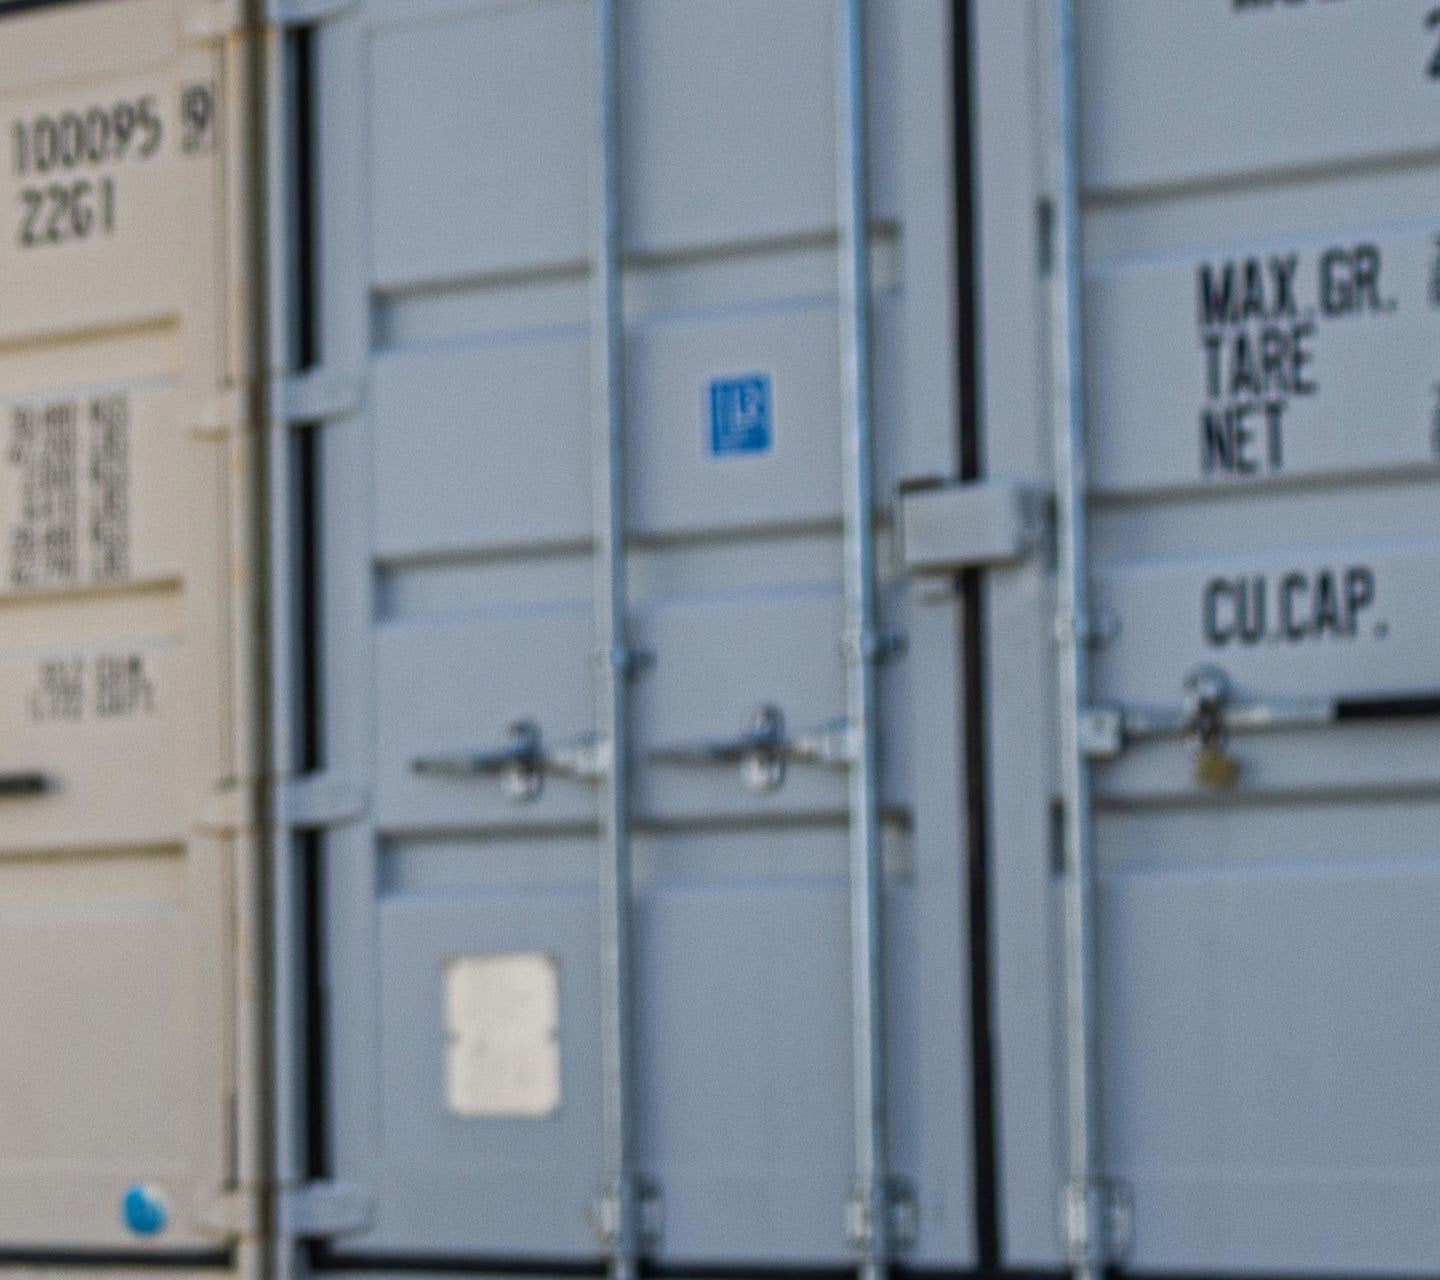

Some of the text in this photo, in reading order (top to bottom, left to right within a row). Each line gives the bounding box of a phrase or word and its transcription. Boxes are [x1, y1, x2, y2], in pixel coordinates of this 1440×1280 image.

[11, 93, 164, 177] 100095
[180, 82, 214, 154] 9
[1200, 322, 1320, 400] TARE
[1199, 401, 1288, 475] NET
